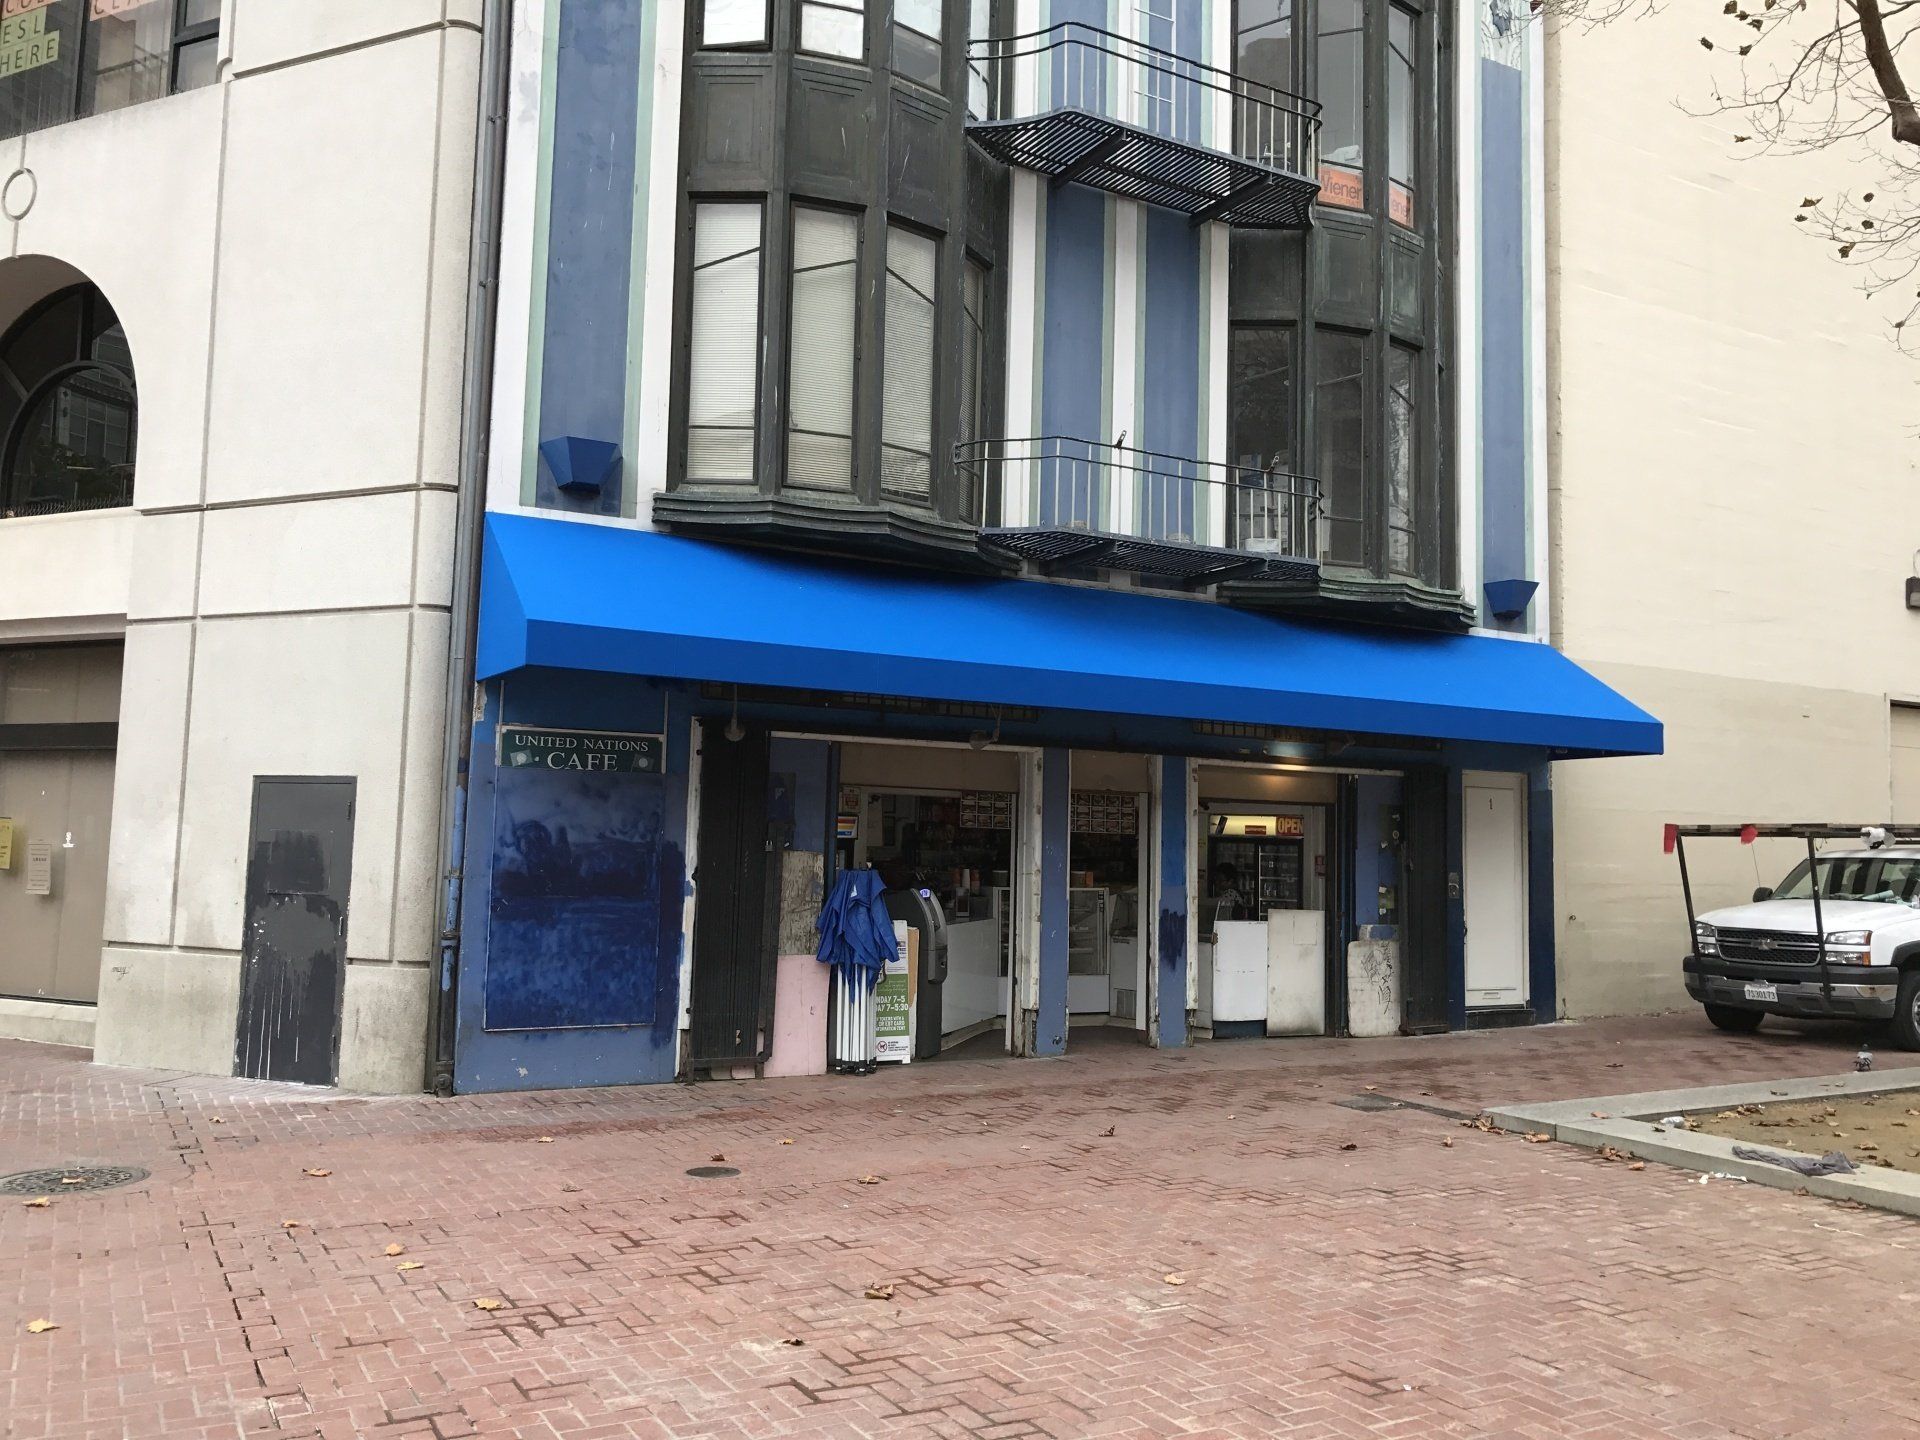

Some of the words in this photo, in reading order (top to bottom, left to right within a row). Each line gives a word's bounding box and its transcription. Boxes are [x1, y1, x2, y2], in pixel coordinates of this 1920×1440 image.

[3, 15, 42, 44] ESL
[0, 38, 56, 73] HERE
[515, 735, 577, 749] UNITED
[584, 738, 649, 752] NATIONS
[547, 751, 619, 772] CAFE
[1278, 818, 1304, 834] OPEN
